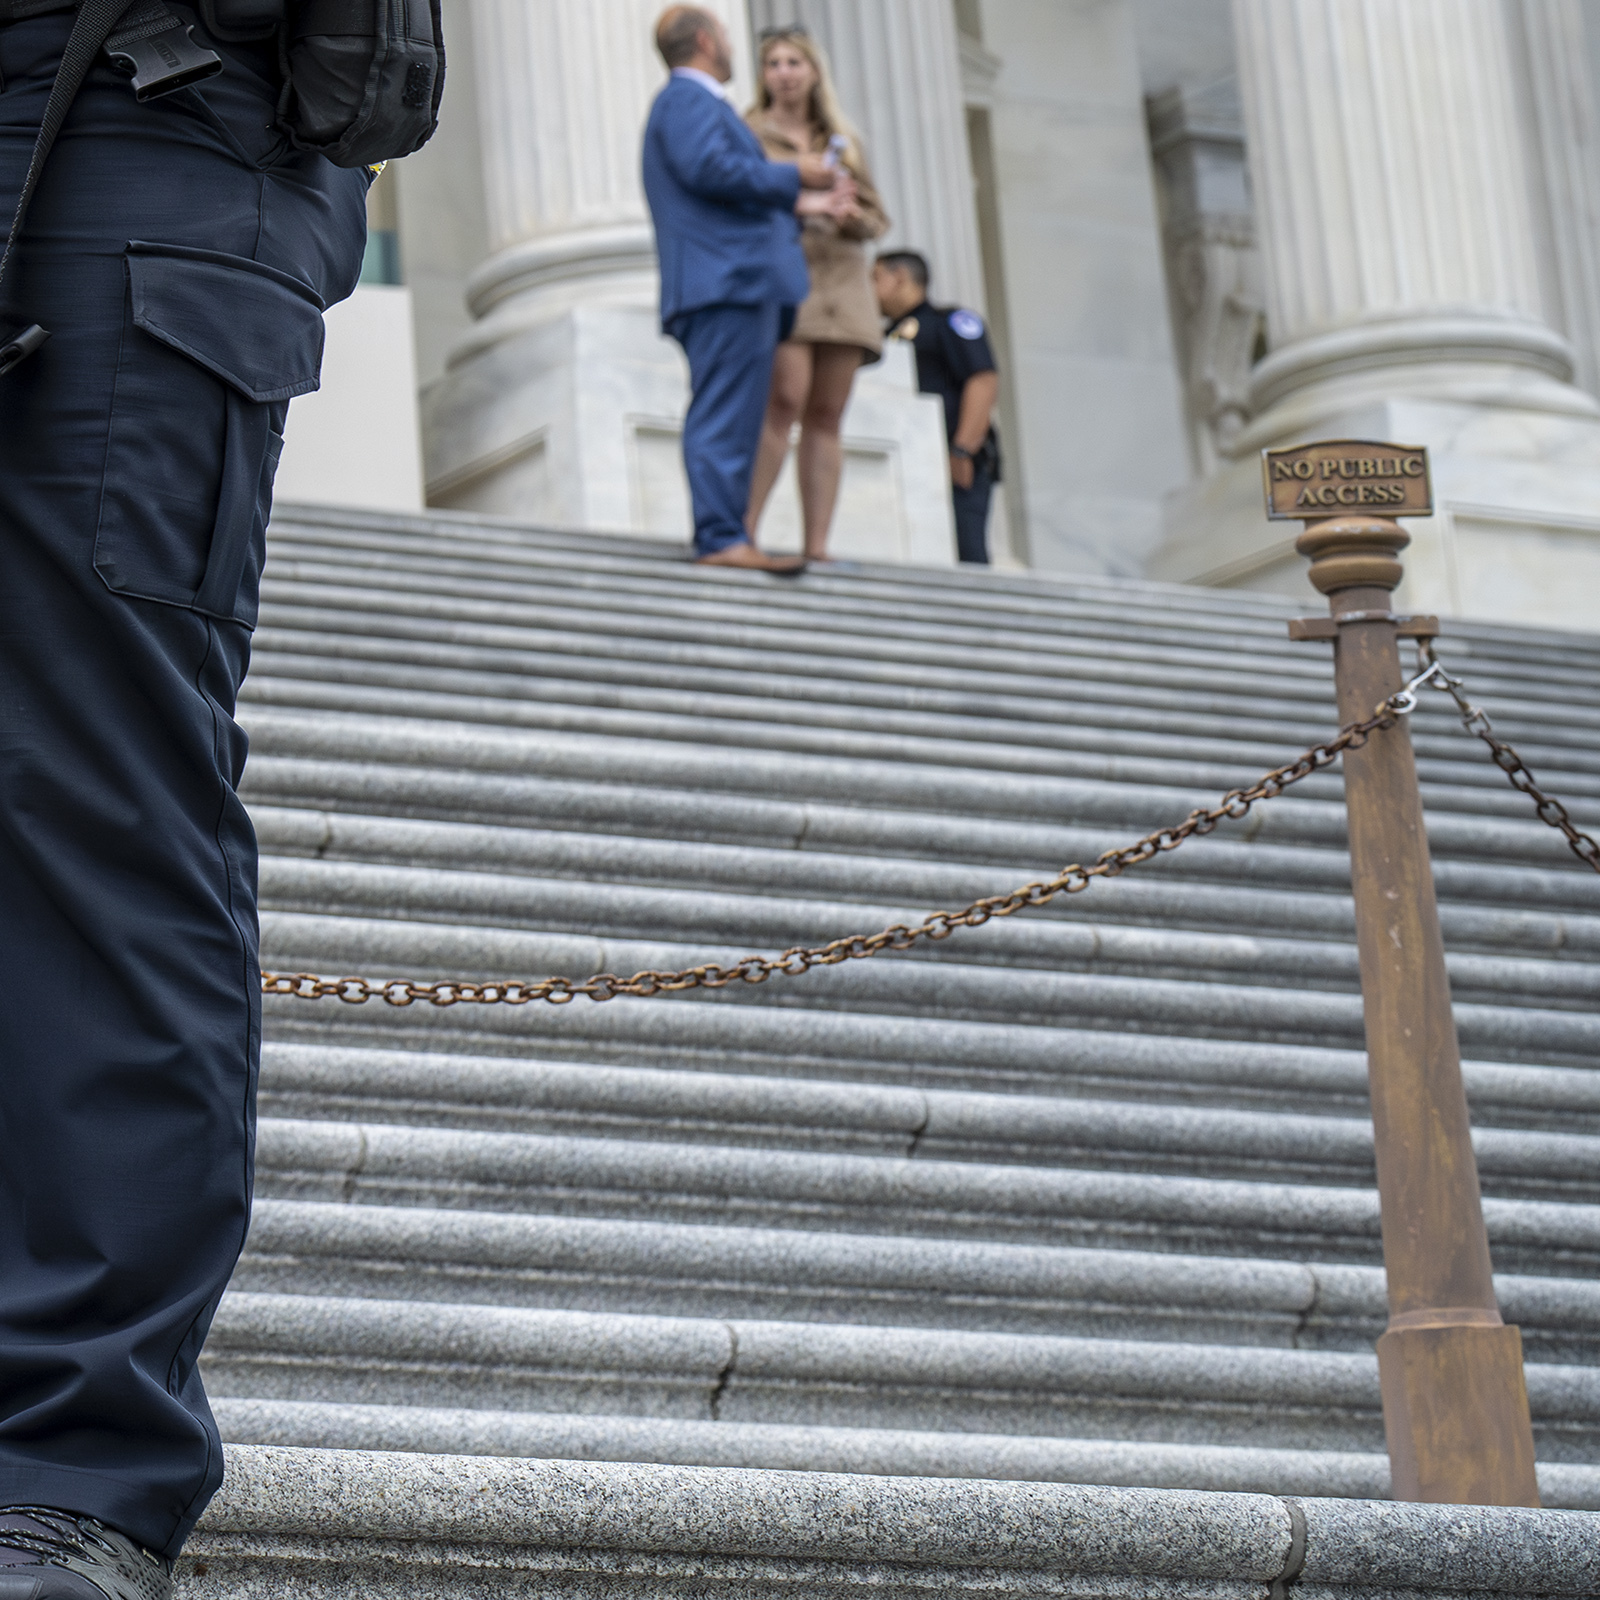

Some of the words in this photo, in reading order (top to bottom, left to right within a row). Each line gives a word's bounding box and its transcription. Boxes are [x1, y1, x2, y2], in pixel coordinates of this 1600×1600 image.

[1274, 458, 1315, 481] NO
[1320, 455, 1424, 480] PUBLIC
[1298, 483, 1406, 507] ACCESS
